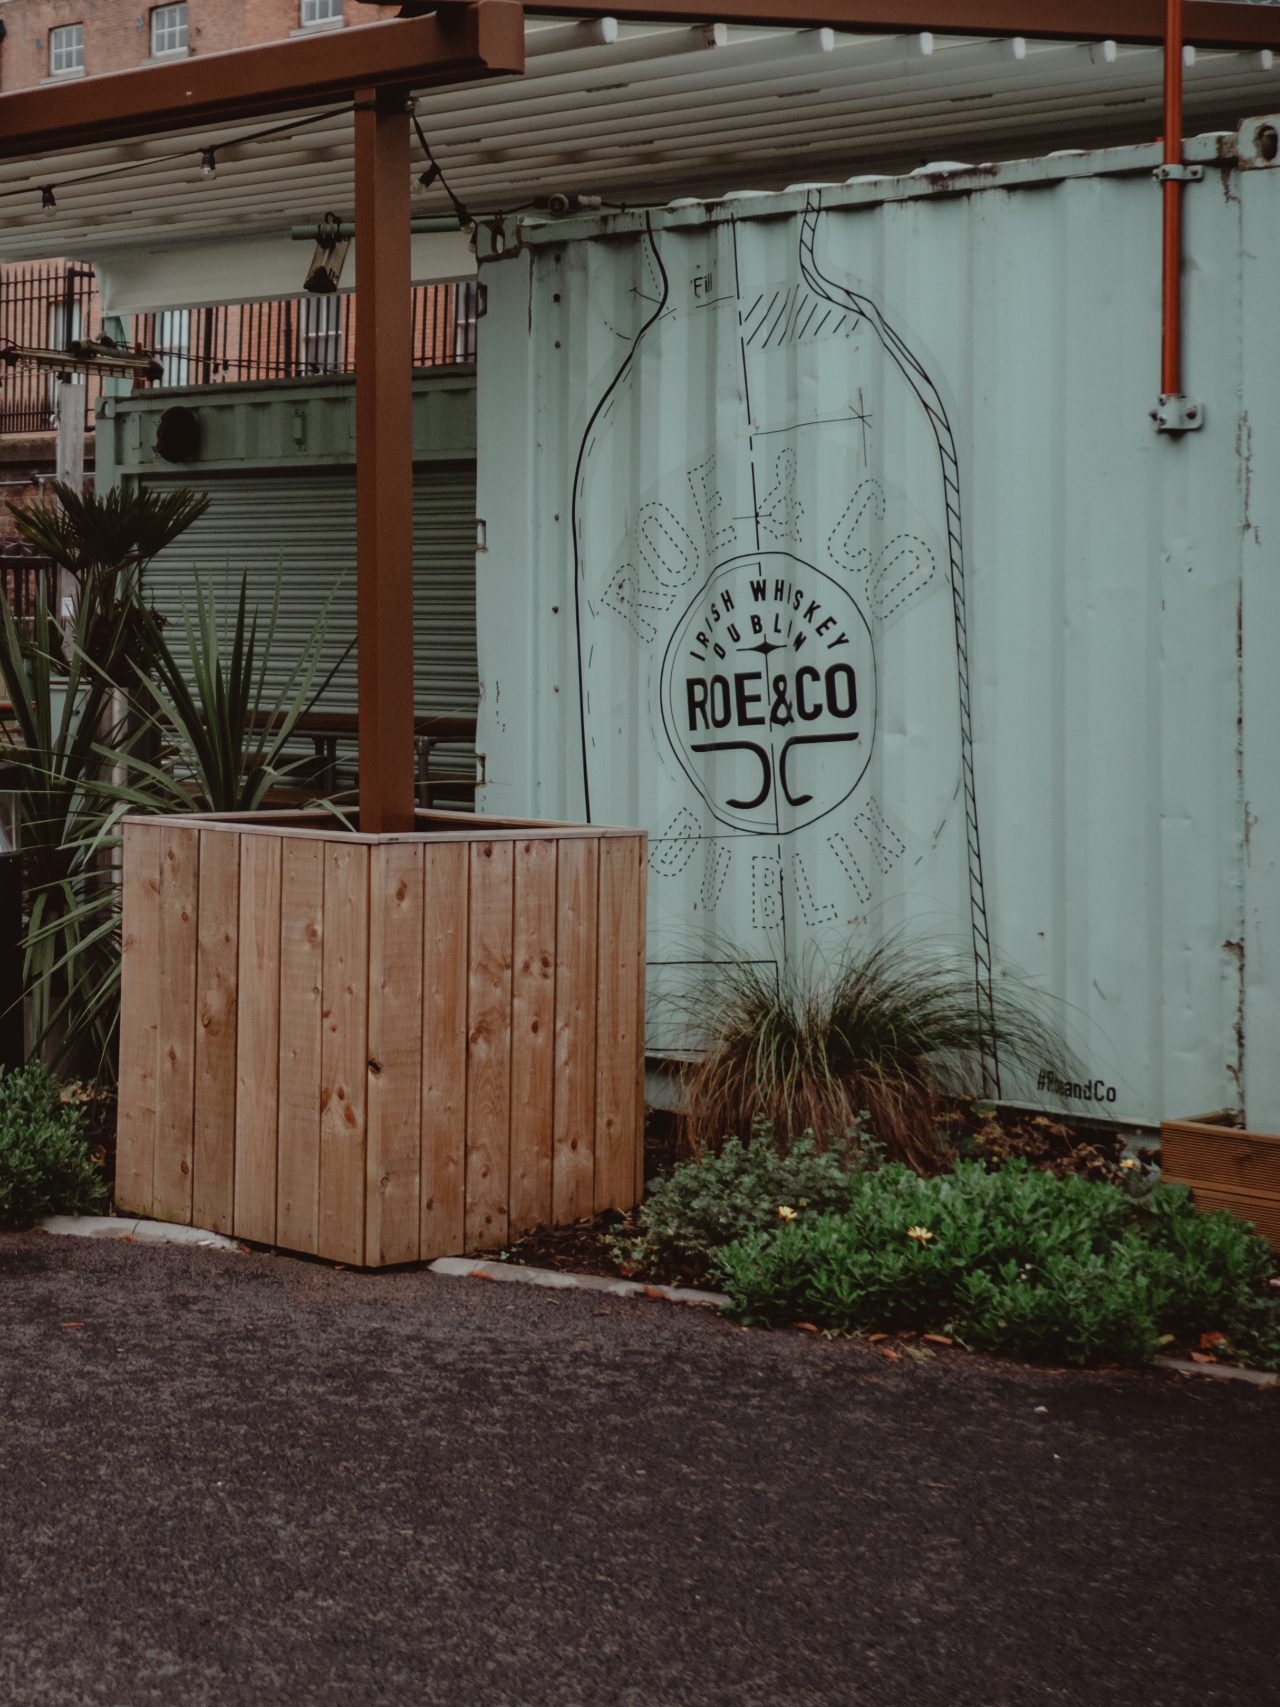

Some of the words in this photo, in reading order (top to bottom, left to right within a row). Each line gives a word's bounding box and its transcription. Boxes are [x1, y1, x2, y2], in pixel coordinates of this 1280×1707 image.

[694, 272, 713, 298] Fill
[690, 589, 734, 661] IRISH
[750, 579, 849, 649] WHISKEY
[713, 613, 807, 660] DUBLIN
[686, 663, 857, 731] ROE&CO
[648, 802, 906, 928] DUBLIN
